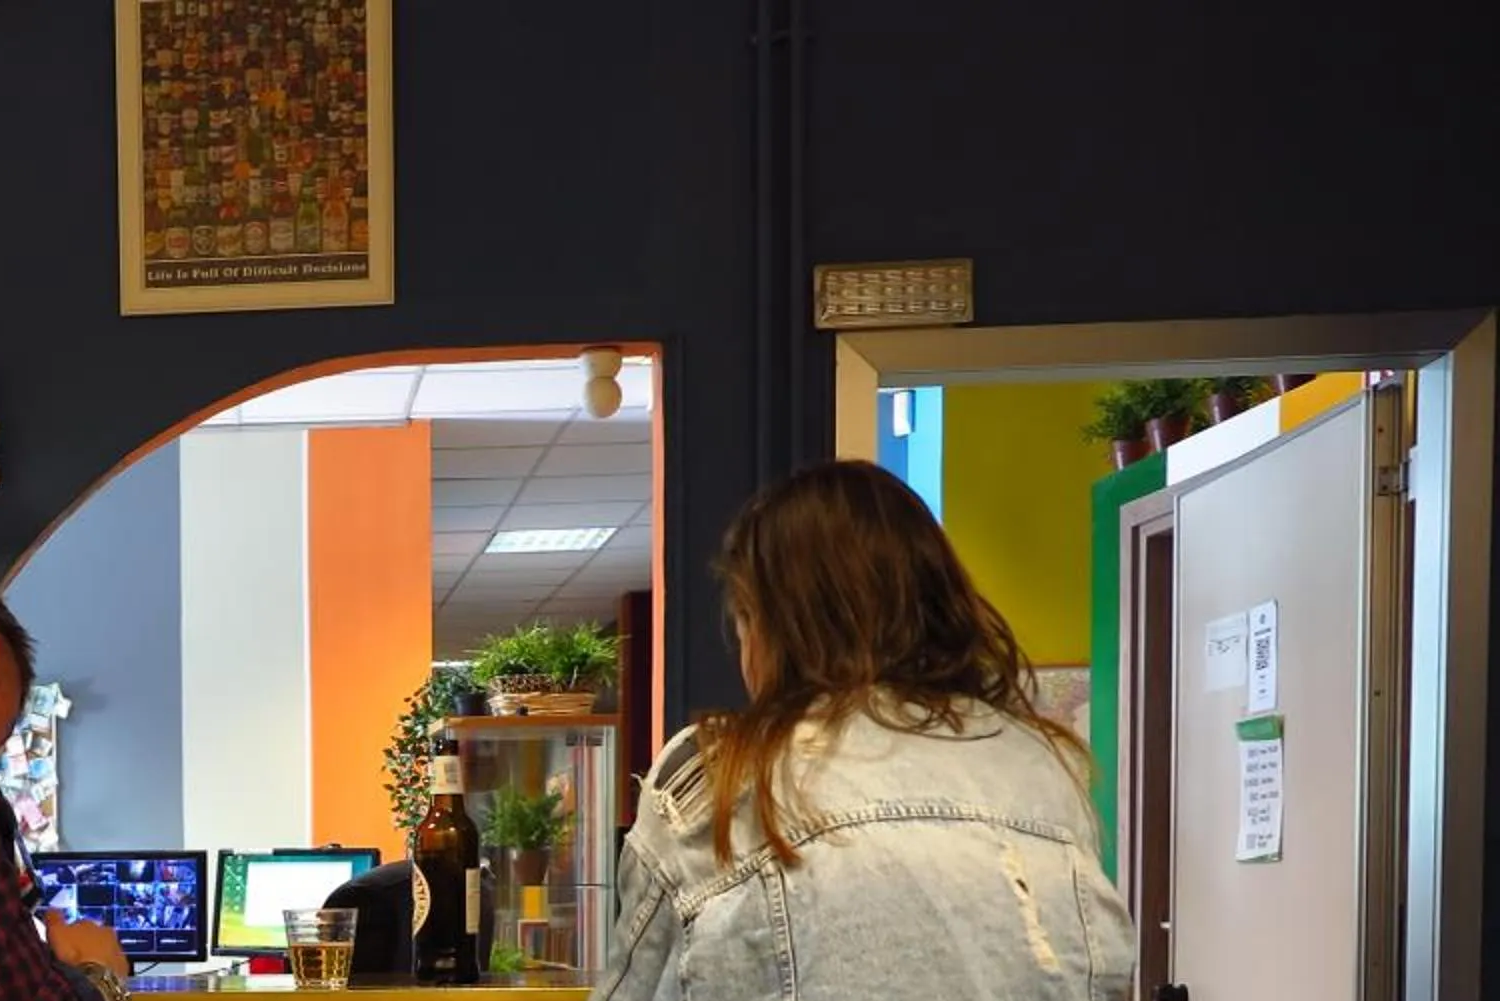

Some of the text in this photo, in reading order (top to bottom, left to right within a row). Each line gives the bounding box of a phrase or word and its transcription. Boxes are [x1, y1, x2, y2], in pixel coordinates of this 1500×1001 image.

[147, 261, 367, 281] Life Is Full Of Difficult Decisions
